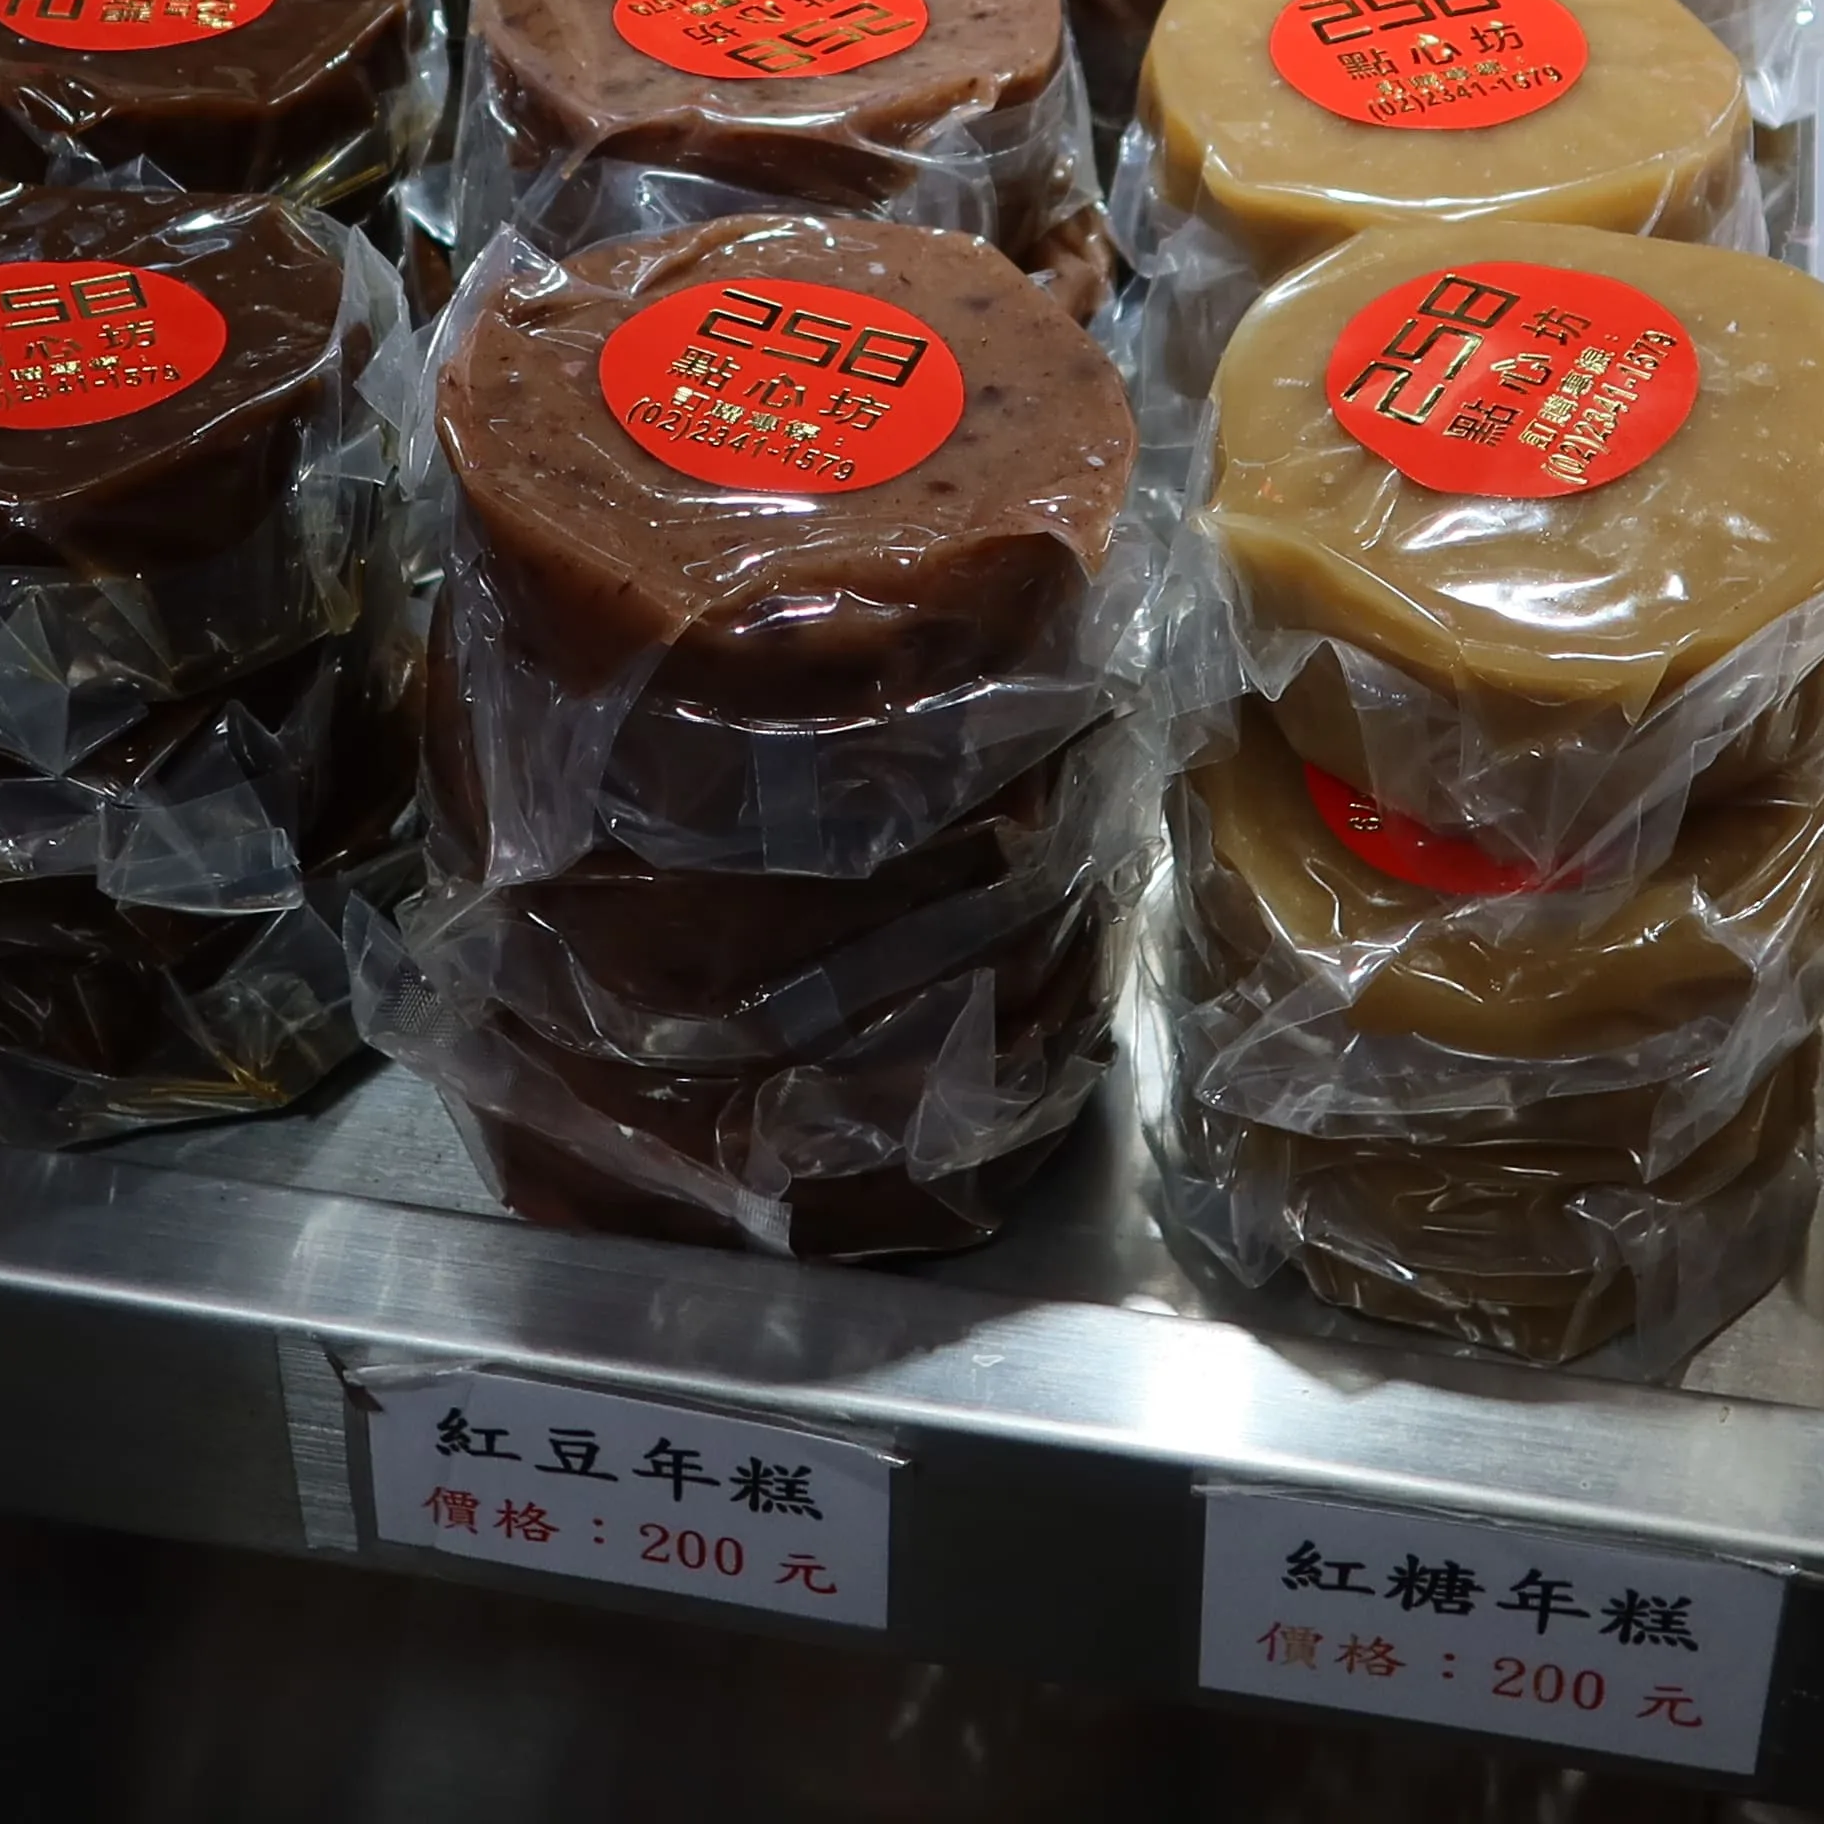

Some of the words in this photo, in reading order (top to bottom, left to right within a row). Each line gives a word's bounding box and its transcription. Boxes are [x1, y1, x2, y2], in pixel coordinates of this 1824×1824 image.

[725, 0, 916, 73] 258
[1338, 21, 1525, 81] 點心坊
[667, 344, 891, 430] 點心坊
[697, 288, 929, 388] 258
[1341, 273, 1520, 426] 258
[1442, 306, 1592, 446] 點心坊
[626, 397, 856, 481] (02)2341-1579
[435, 1407, 824, 1521] 紅豆年糕
[1281, 1539, 1699, 1653] 紅糖年糕
